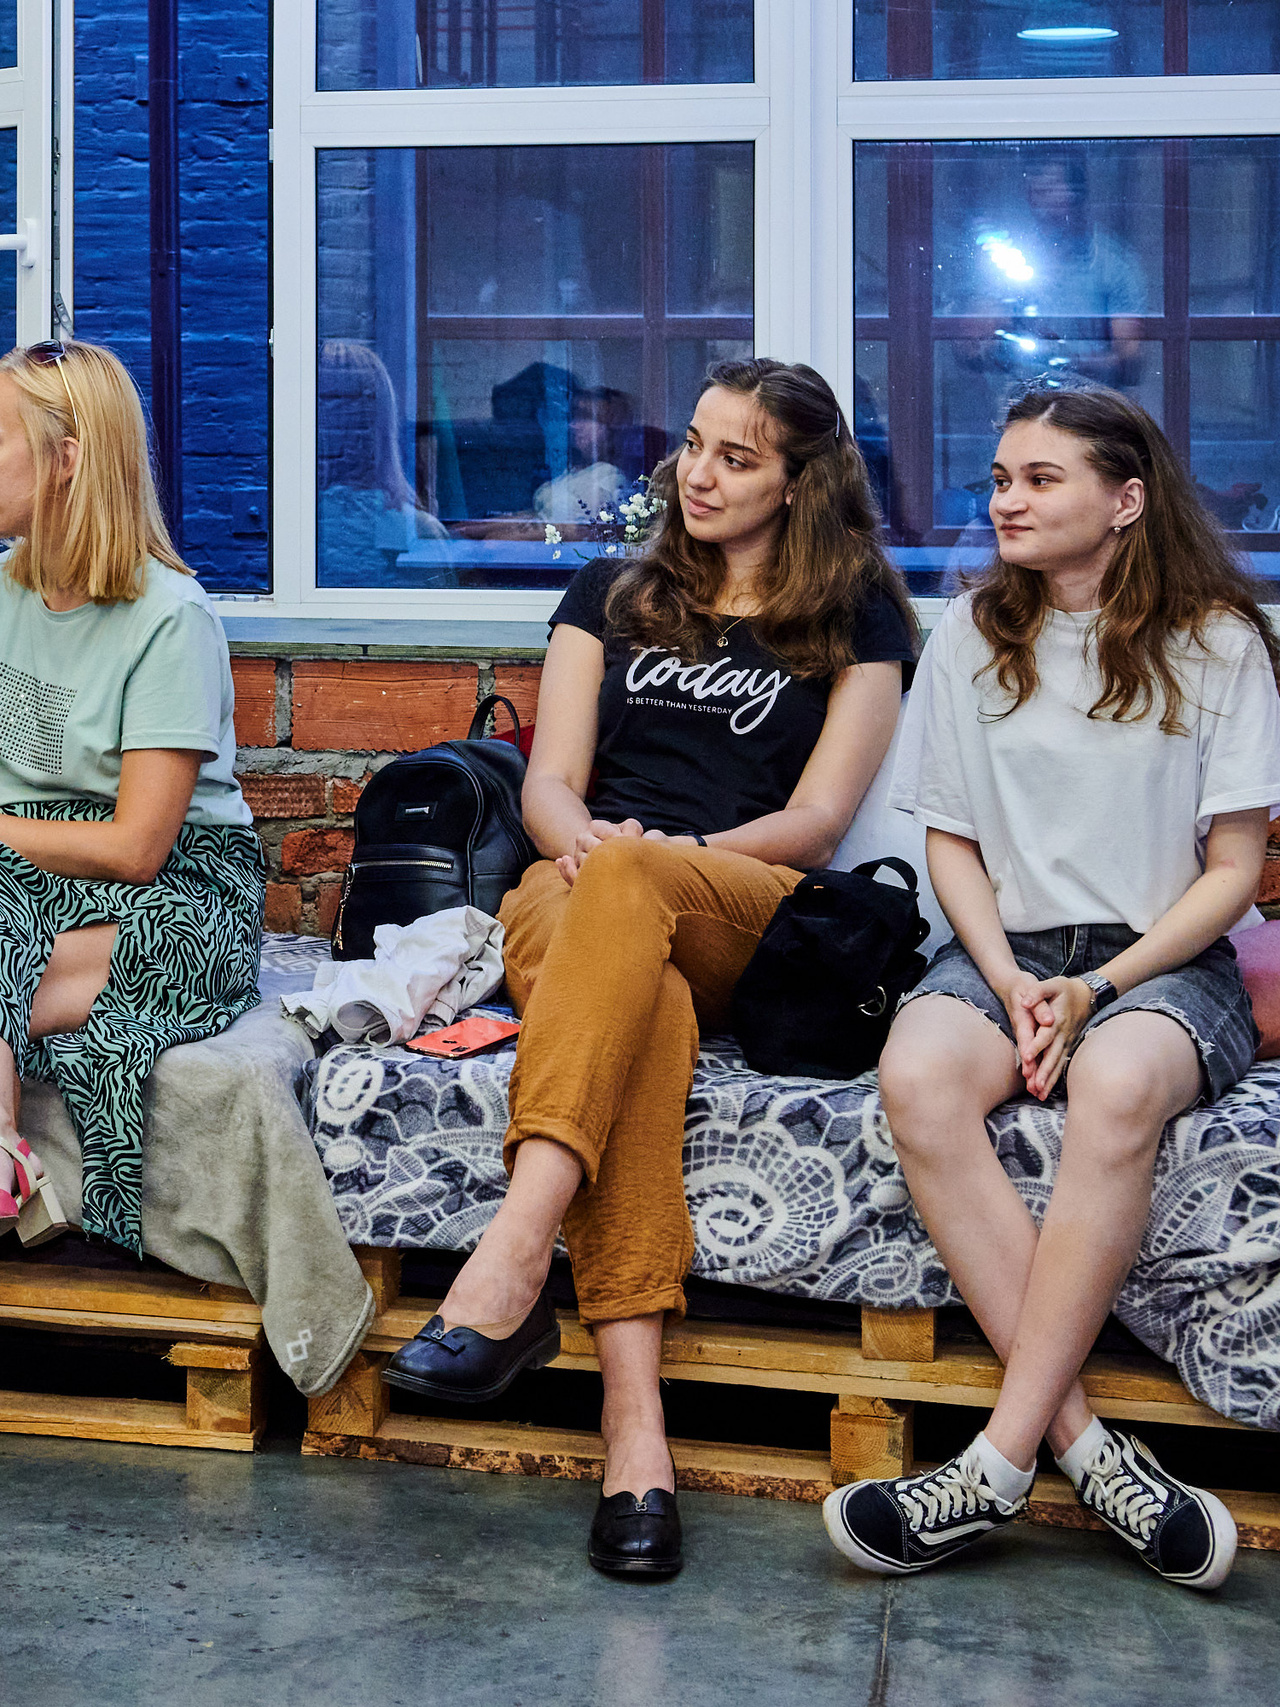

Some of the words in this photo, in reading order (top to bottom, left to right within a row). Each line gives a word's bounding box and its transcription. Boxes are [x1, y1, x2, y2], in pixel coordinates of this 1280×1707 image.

[626, 646, 792, 735] today
[626, 697, 634, 705] IS
[635, 697, 664, 707] BETTER
[666, 700, 687, 710] THAN
[688, 703, 733, 715] YESTERDAY
